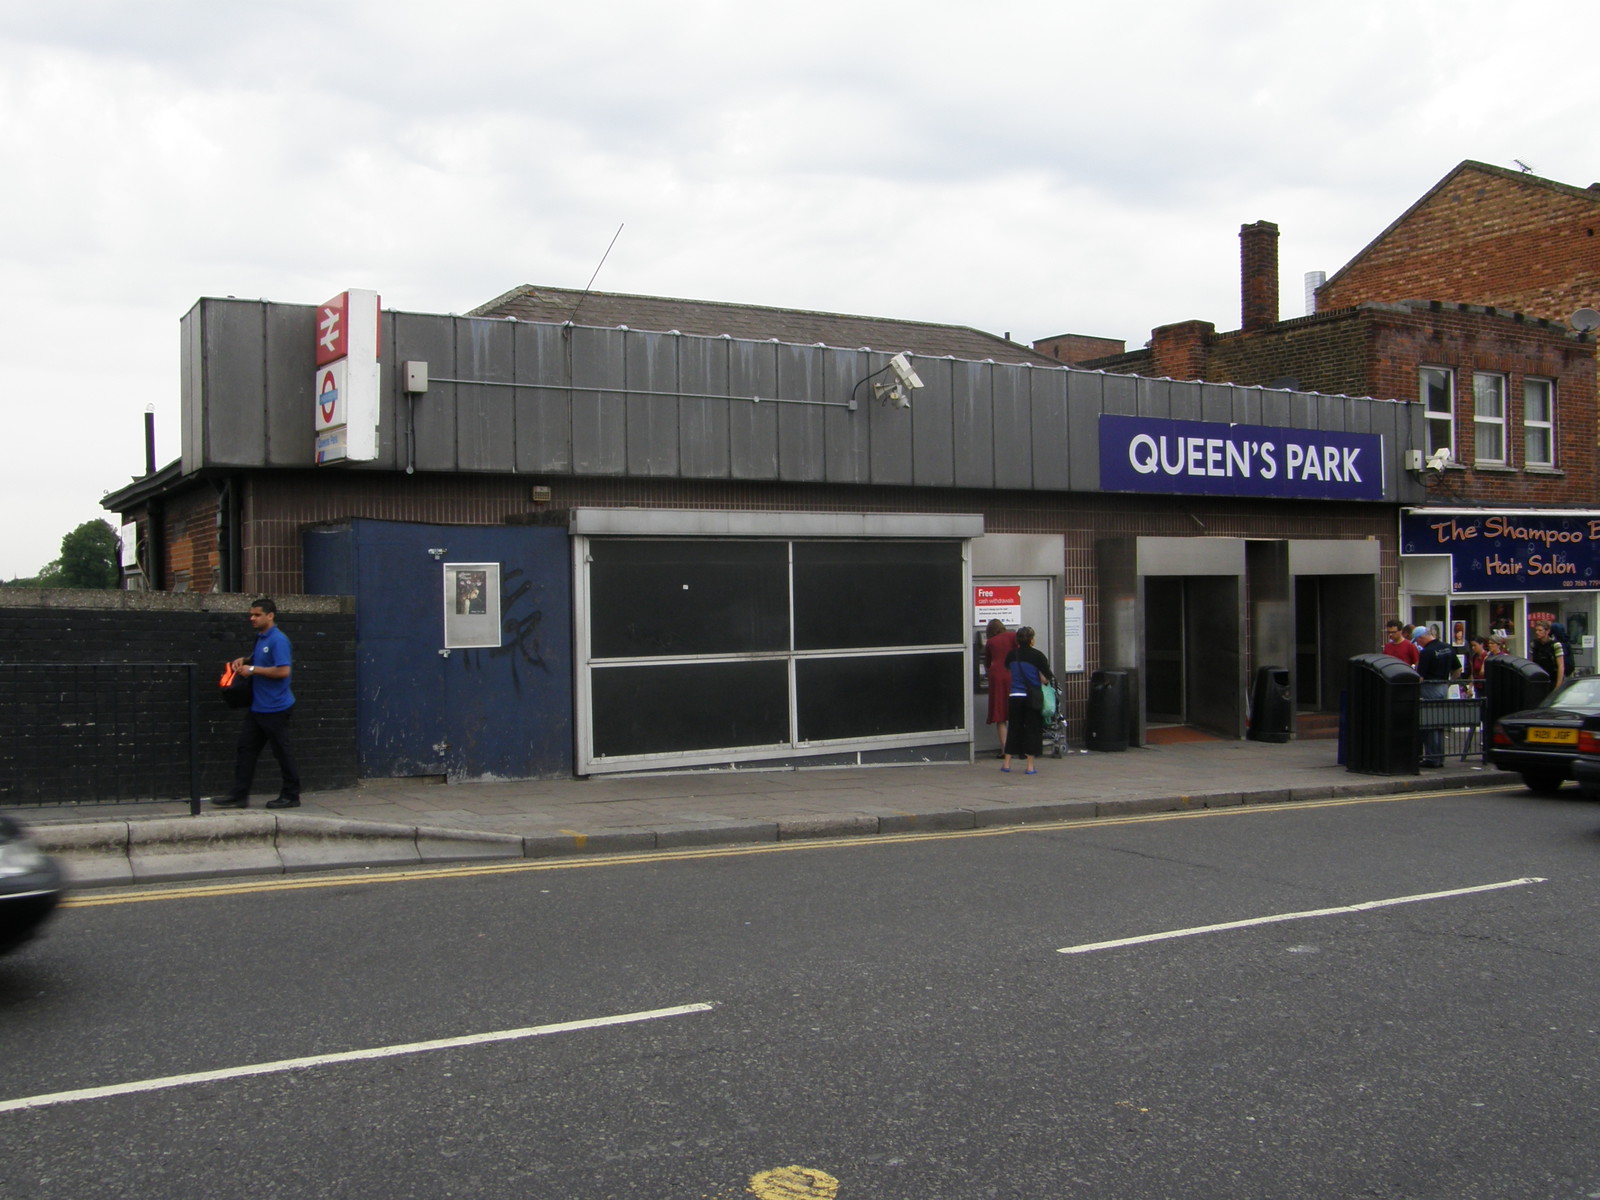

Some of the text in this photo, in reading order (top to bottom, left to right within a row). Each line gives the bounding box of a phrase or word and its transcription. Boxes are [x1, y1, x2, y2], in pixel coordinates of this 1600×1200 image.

[1129, 433, 1362, 483] QUEEN'S PARK
[1430, 519, 1478, 543] The
[1483, 516, 1583, 548] Shampoo
[1485, 553, 1577, 576] Hair Salon
[978, 588, 994, 598] Free
